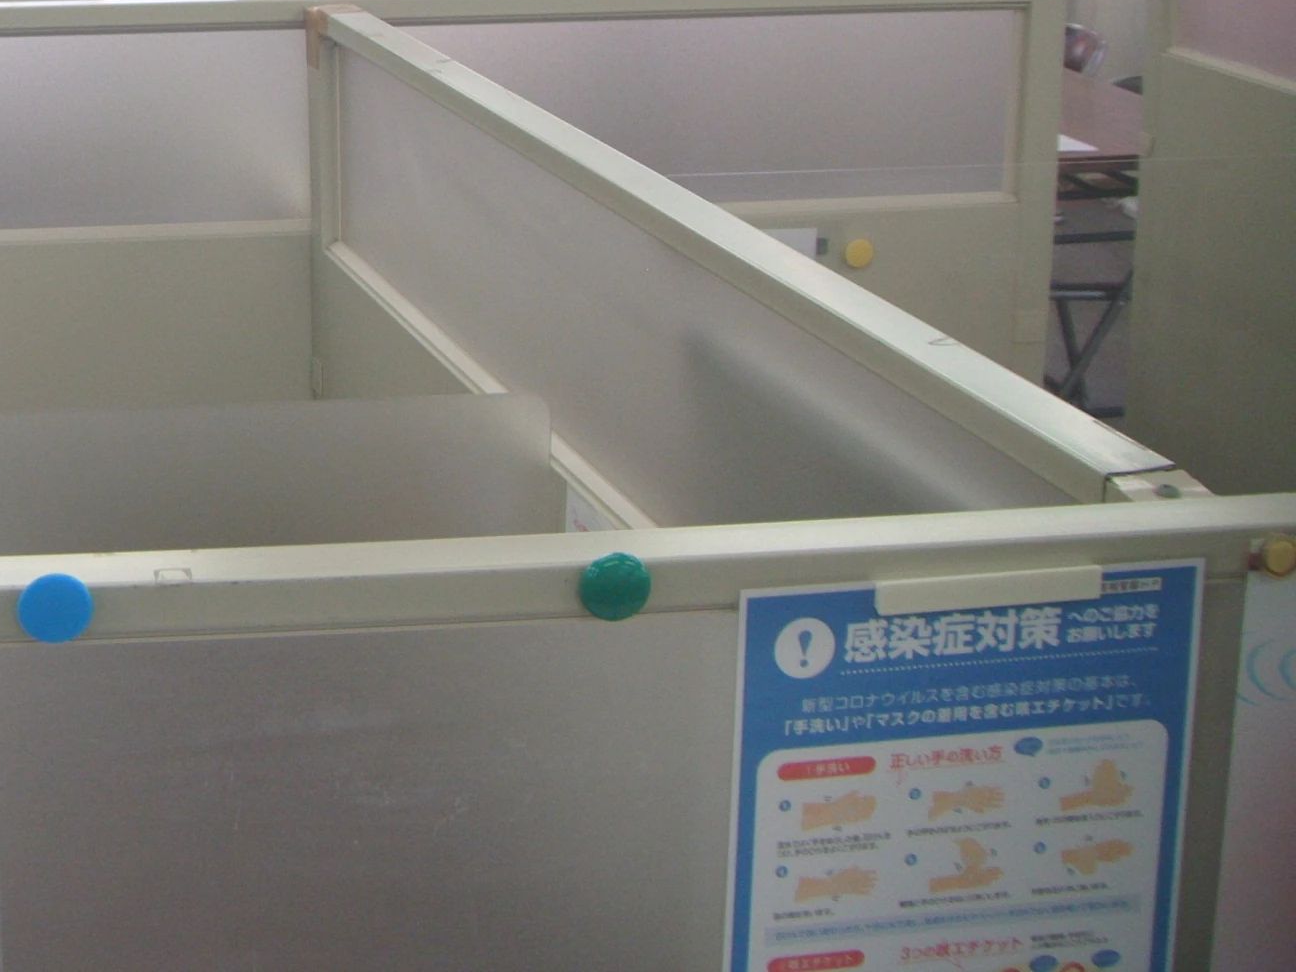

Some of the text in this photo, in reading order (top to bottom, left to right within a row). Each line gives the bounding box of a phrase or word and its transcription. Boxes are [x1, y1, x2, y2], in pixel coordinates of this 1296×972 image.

[843, 605, 1064, 664] 感染症対策
